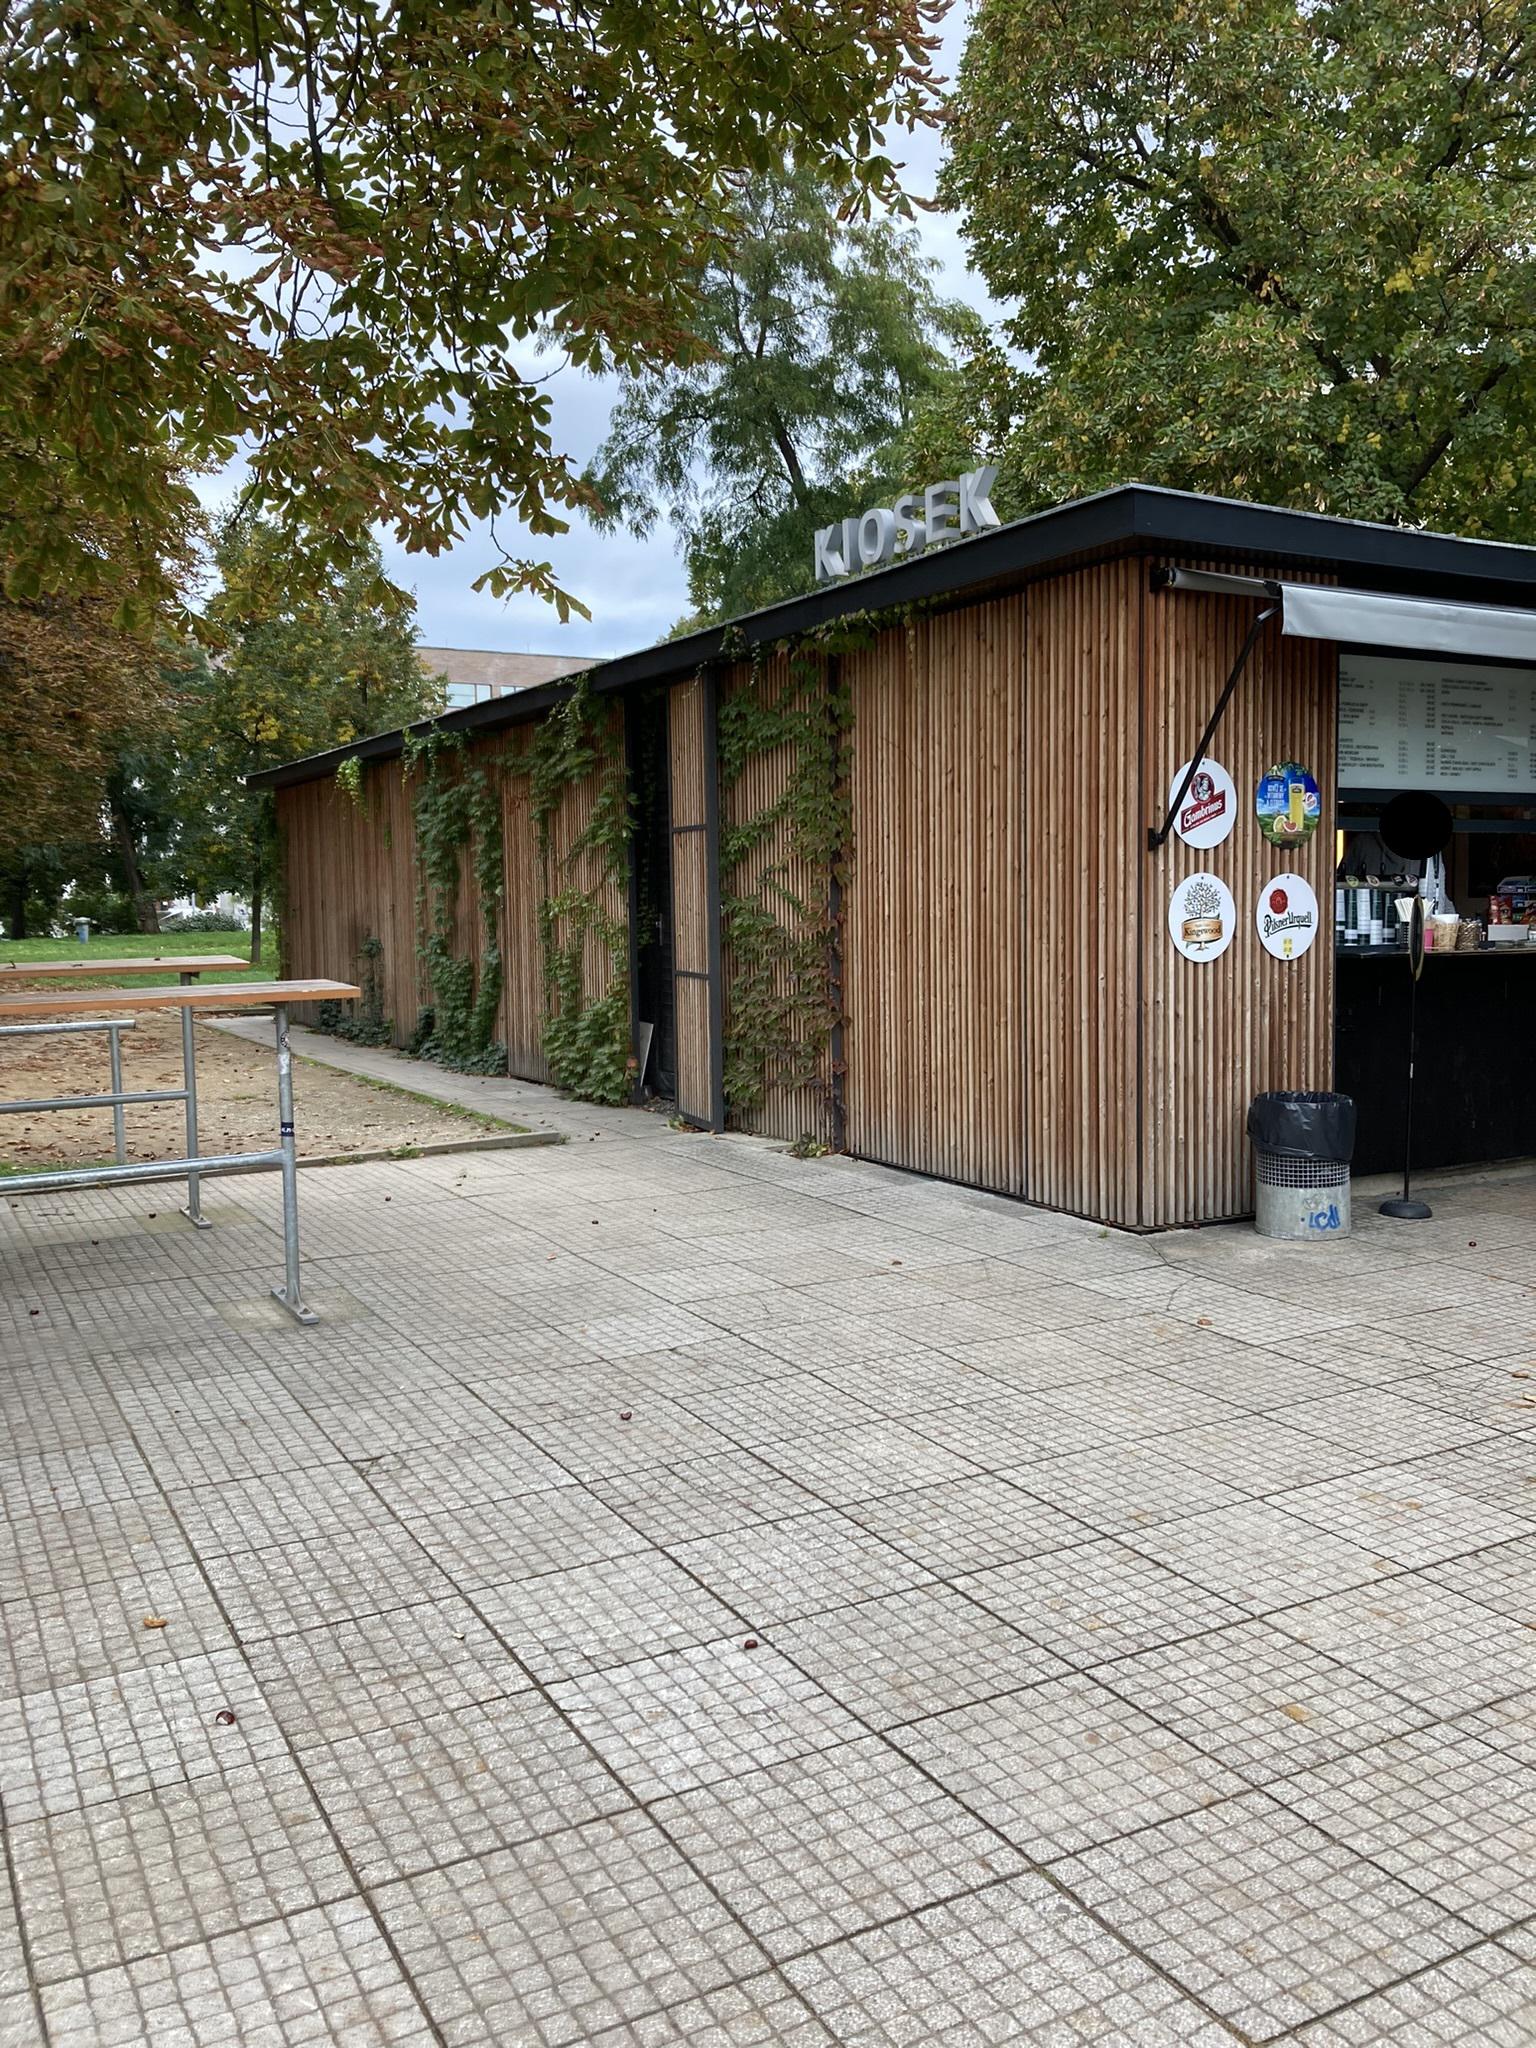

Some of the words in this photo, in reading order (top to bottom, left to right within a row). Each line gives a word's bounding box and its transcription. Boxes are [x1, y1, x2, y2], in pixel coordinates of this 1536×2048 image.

[814, 465, 1001, 580] KIOSEK
[1184, 926, 1221, 938] Kingswood
[1264, 914, 1289, 938] Pilsner
[1288, 911, 1313, 930] Urquell
